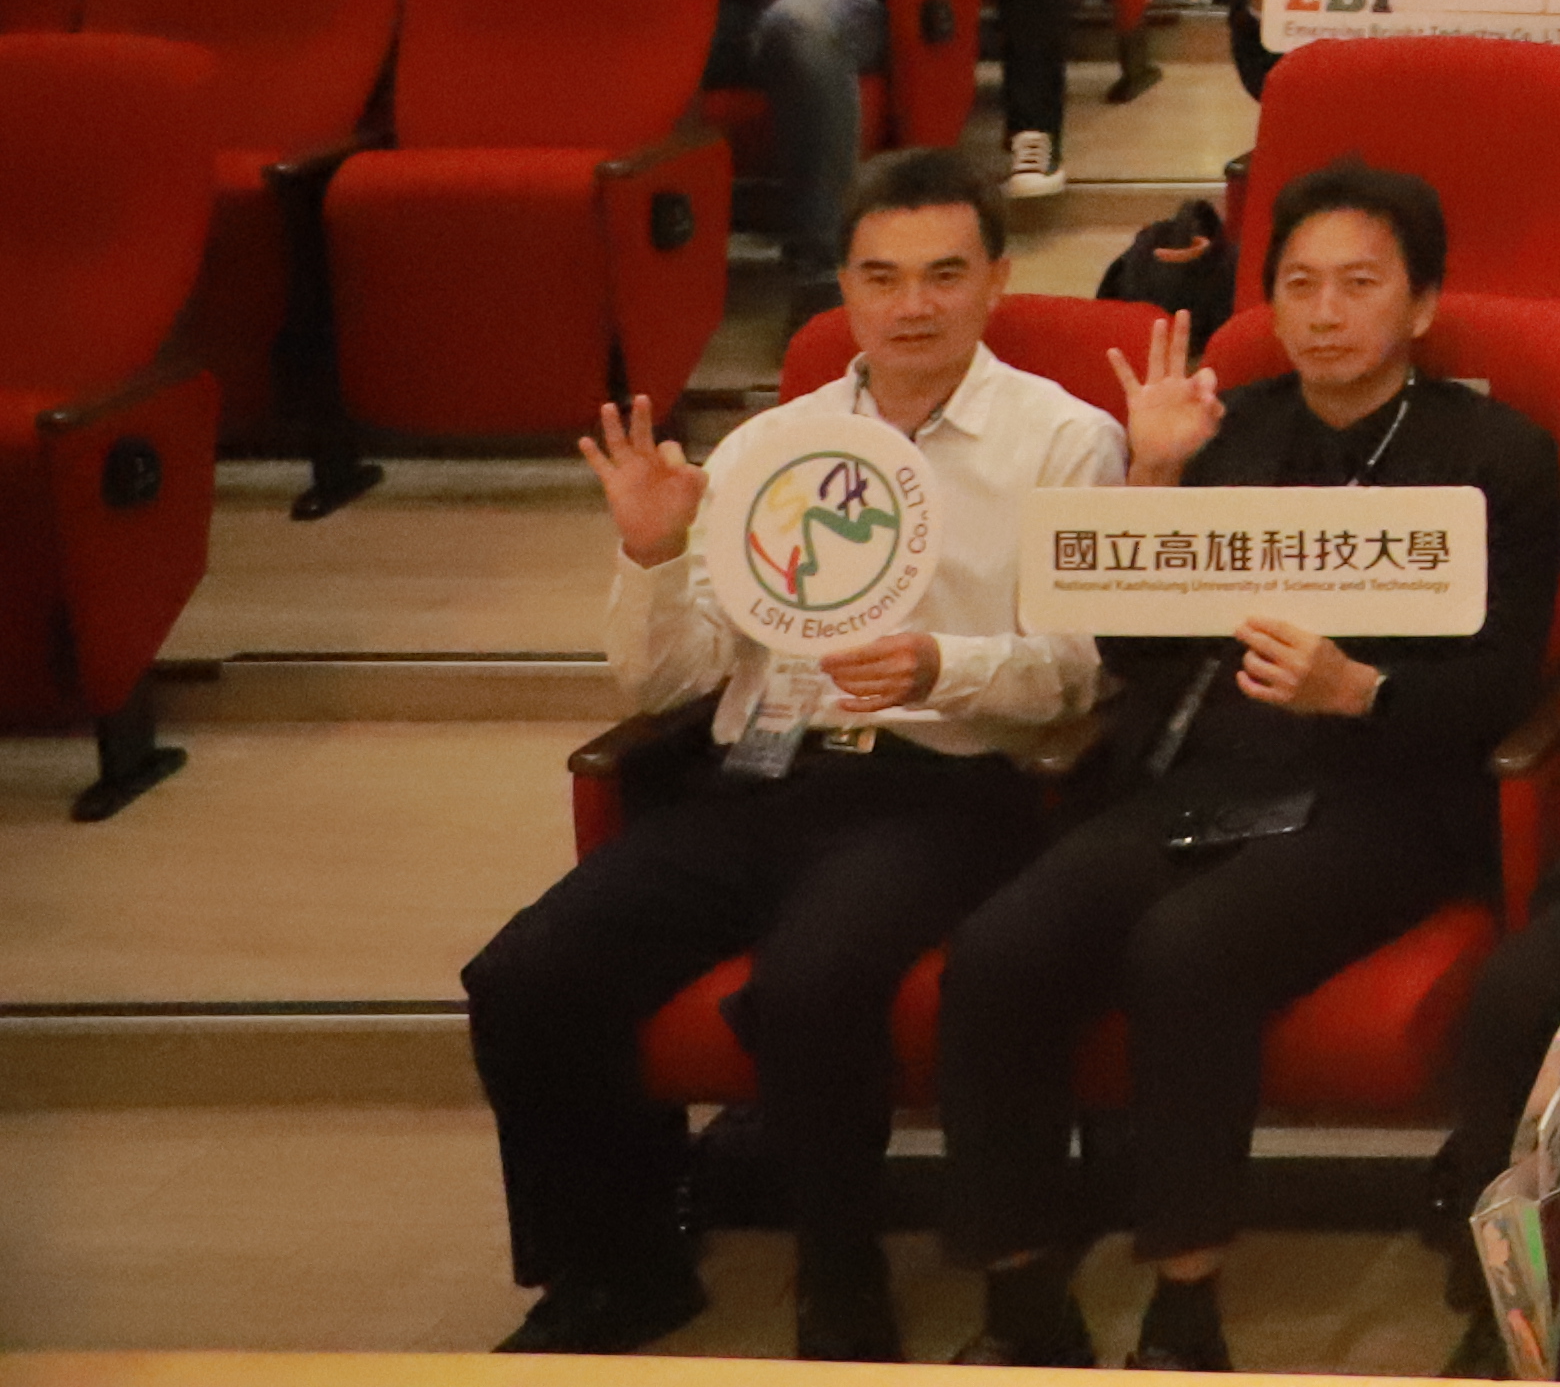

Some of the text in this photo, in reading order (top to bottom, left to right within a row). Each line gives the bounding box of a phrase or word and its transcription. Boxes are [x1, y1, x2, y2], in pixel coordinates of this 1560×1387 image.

[1053, 530, 1450, 571] 國立高雄科技大學
[749, 598, 795, 634] LSH
[801, 564, 919, 639] Electronics
